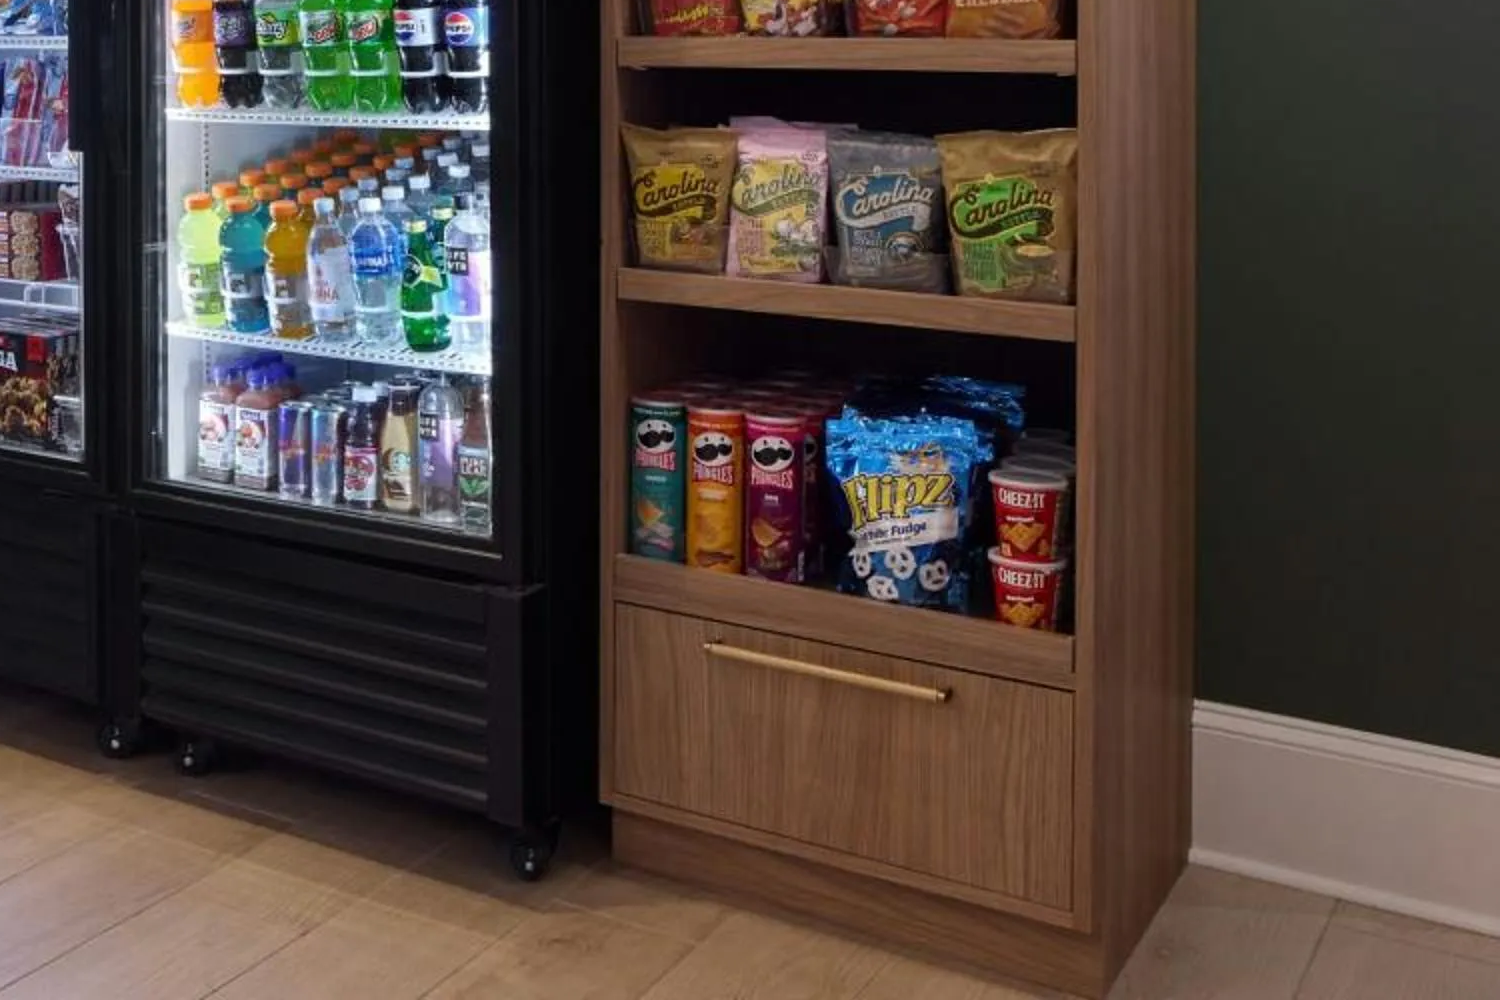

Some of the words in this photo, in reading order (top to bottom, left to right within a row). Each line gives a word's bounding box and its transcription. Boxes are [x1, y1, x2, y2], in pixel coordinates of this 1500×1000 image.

[634, 170, 719, 214] Carolina
[732, 165, 820, 212] Carolina
[836, 175, 935, 225] Carolina
[950, 182, 1052, 234] Carolina
[750, 468, 794, 490] PRINGLES
[998, 488, 1045, 509] CHEEZ-IT
[843, 473, 954, 531] Flipz
[891, 521, 927, 536] Fudge
[998, 567, 1045, 590] CHEEZ-IT
